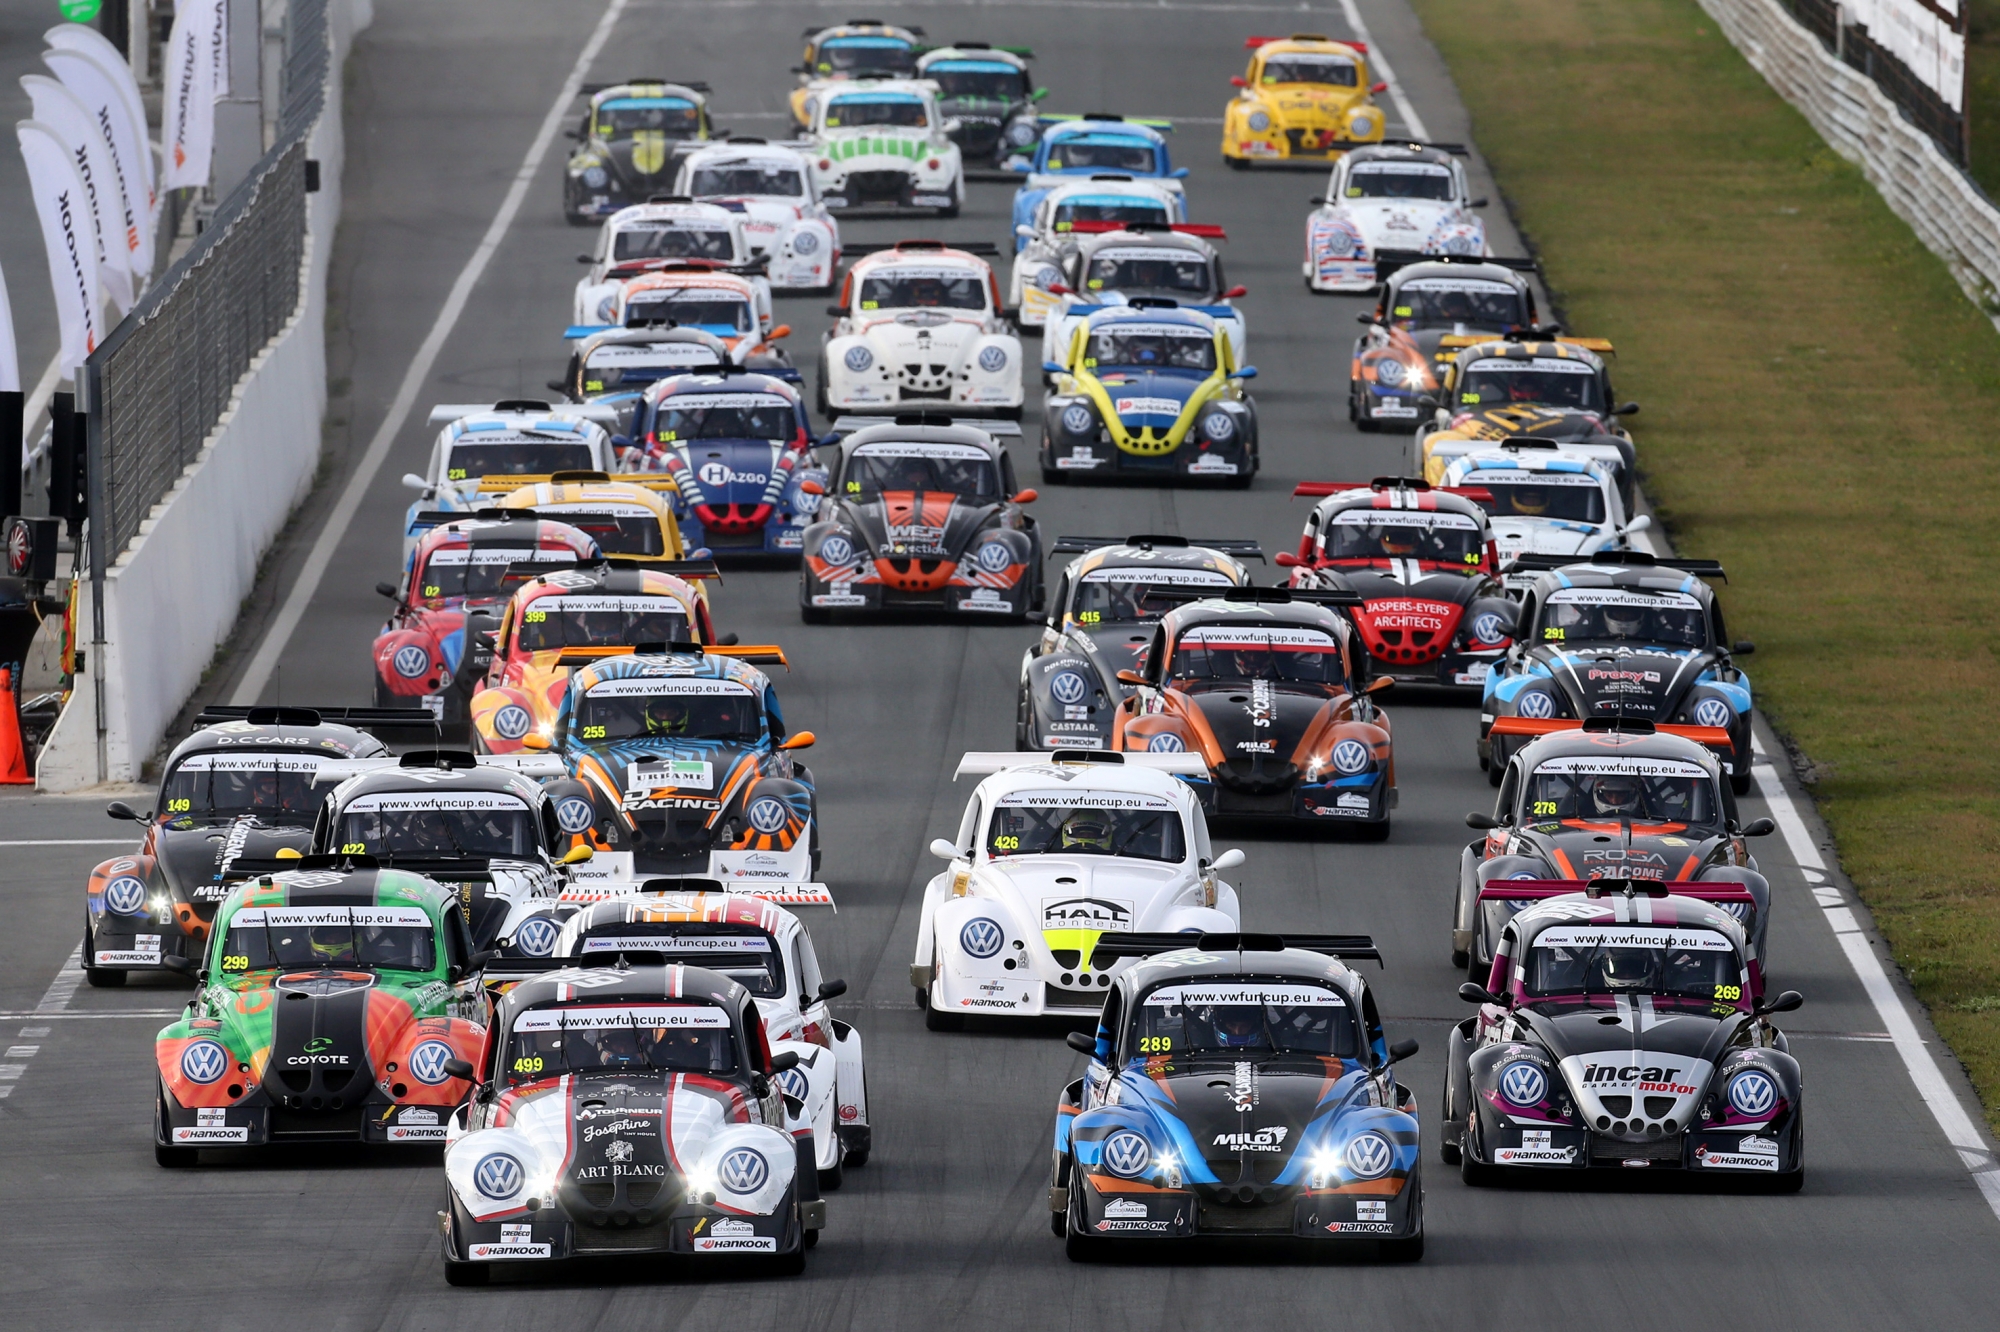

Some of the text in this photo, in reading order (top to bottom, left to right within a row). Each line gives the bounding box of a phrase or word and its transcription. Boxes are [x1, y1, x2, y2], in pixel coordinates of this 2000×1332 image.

[878, 447, 964, 457] www.vwfuncup.eu
[449, 469, 466, 479] 274
[847, 482, 860, 492] 04
[1464, 553, 1479, 564] 44
[1110, 572, 1206, 584] www.vwfuncup.eu
[425, 586, 440, 597] 02
[558, 600, 655, 611] www.vwfuncup.eu
[1577, 594, 1673, 607] www.vwfuncup.eu
[1366, 600, 1450, 616] JASPERS-EYERS
[525, 612, 546, 623] 399
[1080, 612, 1100, 622] 415
[1374, 616, 1443, 630] ARCHITECTS
[1205, 633, 1304, 643] www.vwfuncup.eu
[1545, 628, 1565, 639] 291
[1588, 669, 1644, 682] Proxy
[615, 682, 720, 696] www.vwfuncup.eu
[1625, 703, 1656, 711] CARS
[583, 726, 605, 739] 255
[1050, 722, 1099, 732] CASTAAR.
[255, 736, 310, 746] CARS
[208, 758, 318, 771] www.vwfuncup.eu
[1567, 763, 1676, 775] www.vwfuncup.eu
[168, 799, 190, 812] 149
[381, 797, 493, 809] www.vwfuncup.eu
[621, 798, 721, 812] RACING
[1028, 796, 1141, 808] www.vwfuncup.eu
[1534, 802, 1557, 814] 278
[994, 836, 1018, 849] 426
[342, 844, 365, 855] 422
[1583, 849, 1668, 866] ROSA
[271, 913, 393, 925] www.vwfuncup.eu
[1045, 909, 1129, 923] HALL
[1045, 919, 1129, 931] concept
[617, 938, 737, 950] www.vwfuncup.eu
[1574, 933, 1697, 948] www.vwfuncup.eu
[223, 956, 248, 969] 299
[979, 984, 1005, 992] CREDECO
[1714, 985, 1740, 1000] 269
[1181, 990, 1311, 1005] www.vwfuncup.eu
[557, 1013, 688, 1028] www.vwfuncup.eu
[1140, 1037, 1171, 1051] 289
[287, 1055, 349, 1066] COYOTE
[514, 1057, 543, 1073] 499
[1582, 1063, 1682, 1084] incar
[1581, 1081, 1637, 1089] GARAGE
[1638, 1080, 1698, 1095] motor
[594, 1107, 662, 1115] TOURNEUR
[583, 1119, 651, 1142] Josephine
[1230, 1144, 1282, 1152] RACING
[577, 1164, 664, 1179] ART BLANC
[1357, 1207, 1385, 1215] CREDECO
